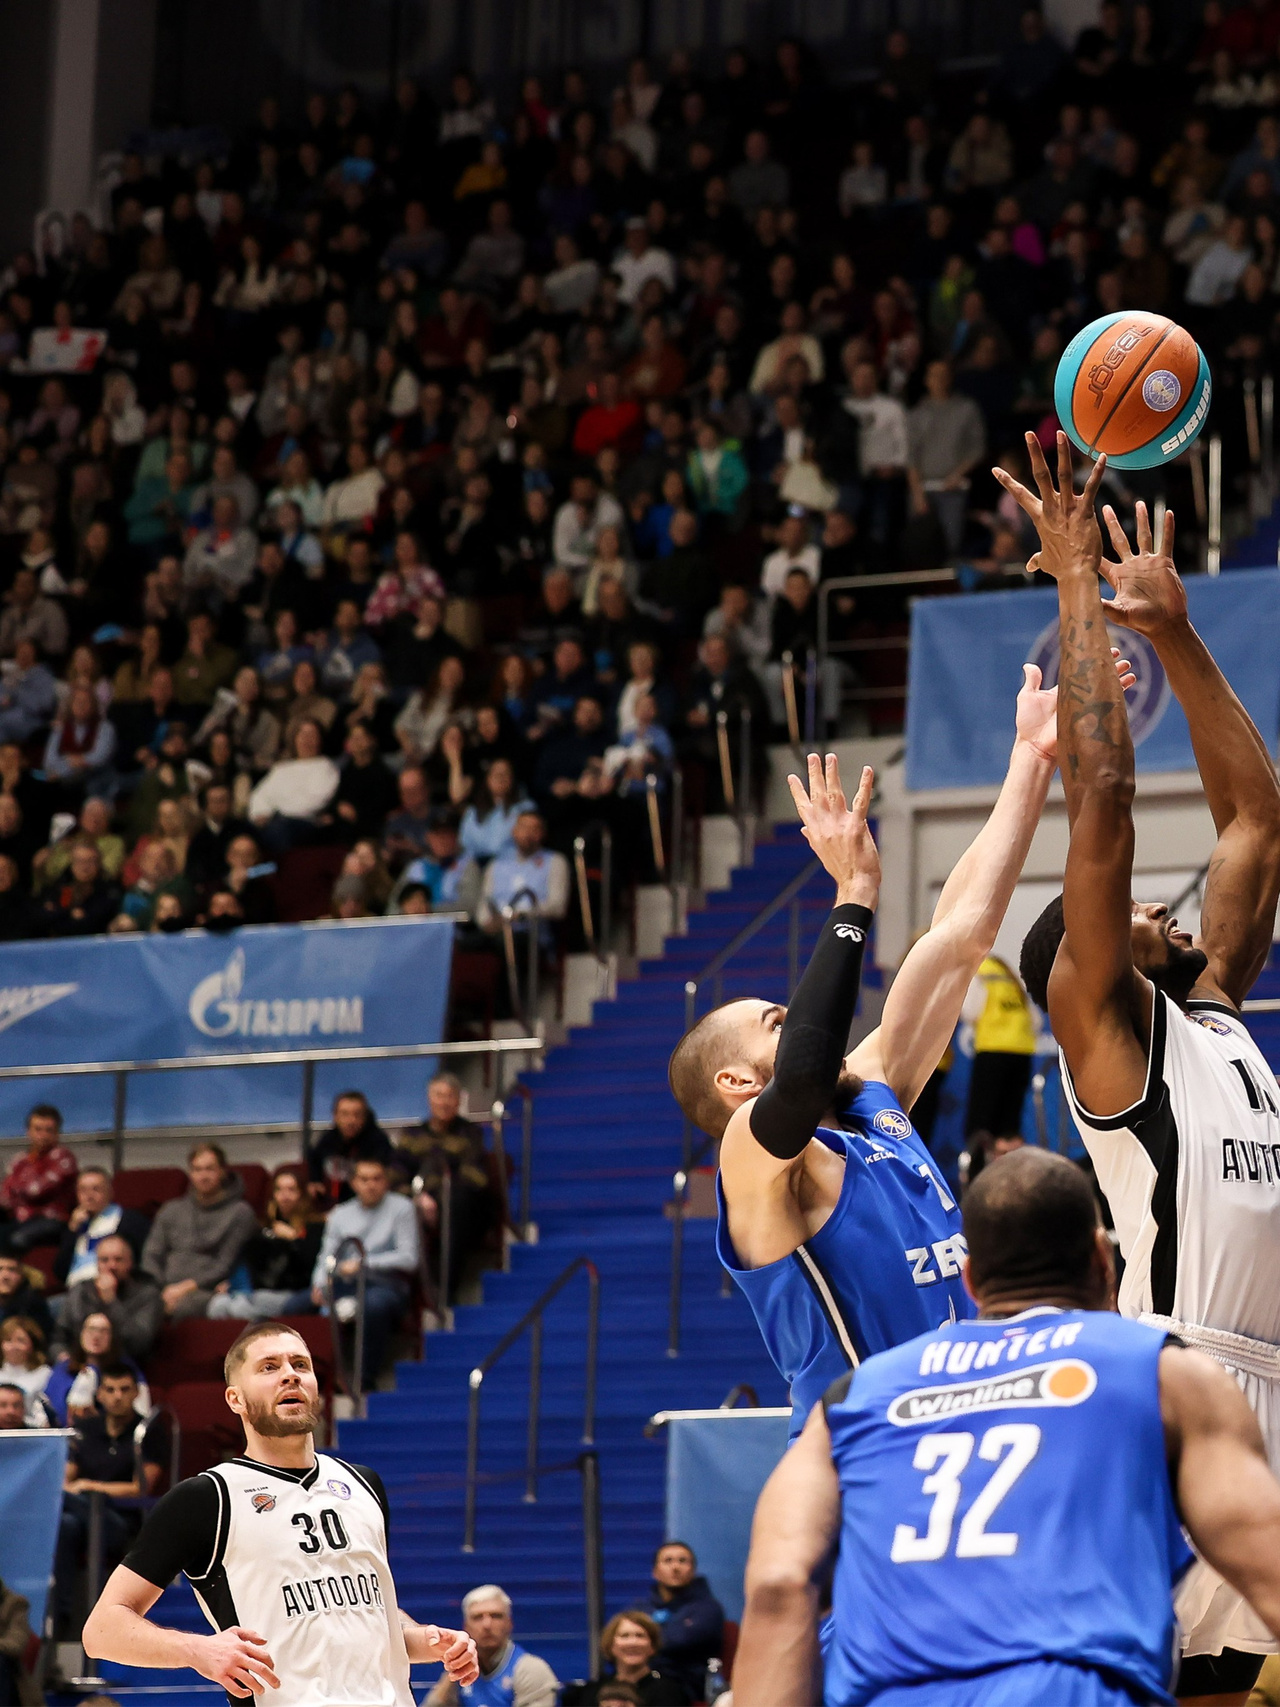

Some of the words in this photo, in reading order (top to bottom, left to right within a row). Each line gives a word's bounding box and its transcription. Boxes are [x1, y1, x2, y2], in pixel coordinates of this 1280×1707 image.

[1088, 325, 1154, 410] JÖGEL
[1160, 379, 1211, 456] SIBUR
[919, 1321, 1084, 1376] HUNTER
[909, 1377, 1034, 1418] Winline
[890, 1423, 1042, 1564] 32
[291, 1508, 351, 1555] 30
[281, 1573, 384, 1620] AVTODOR
